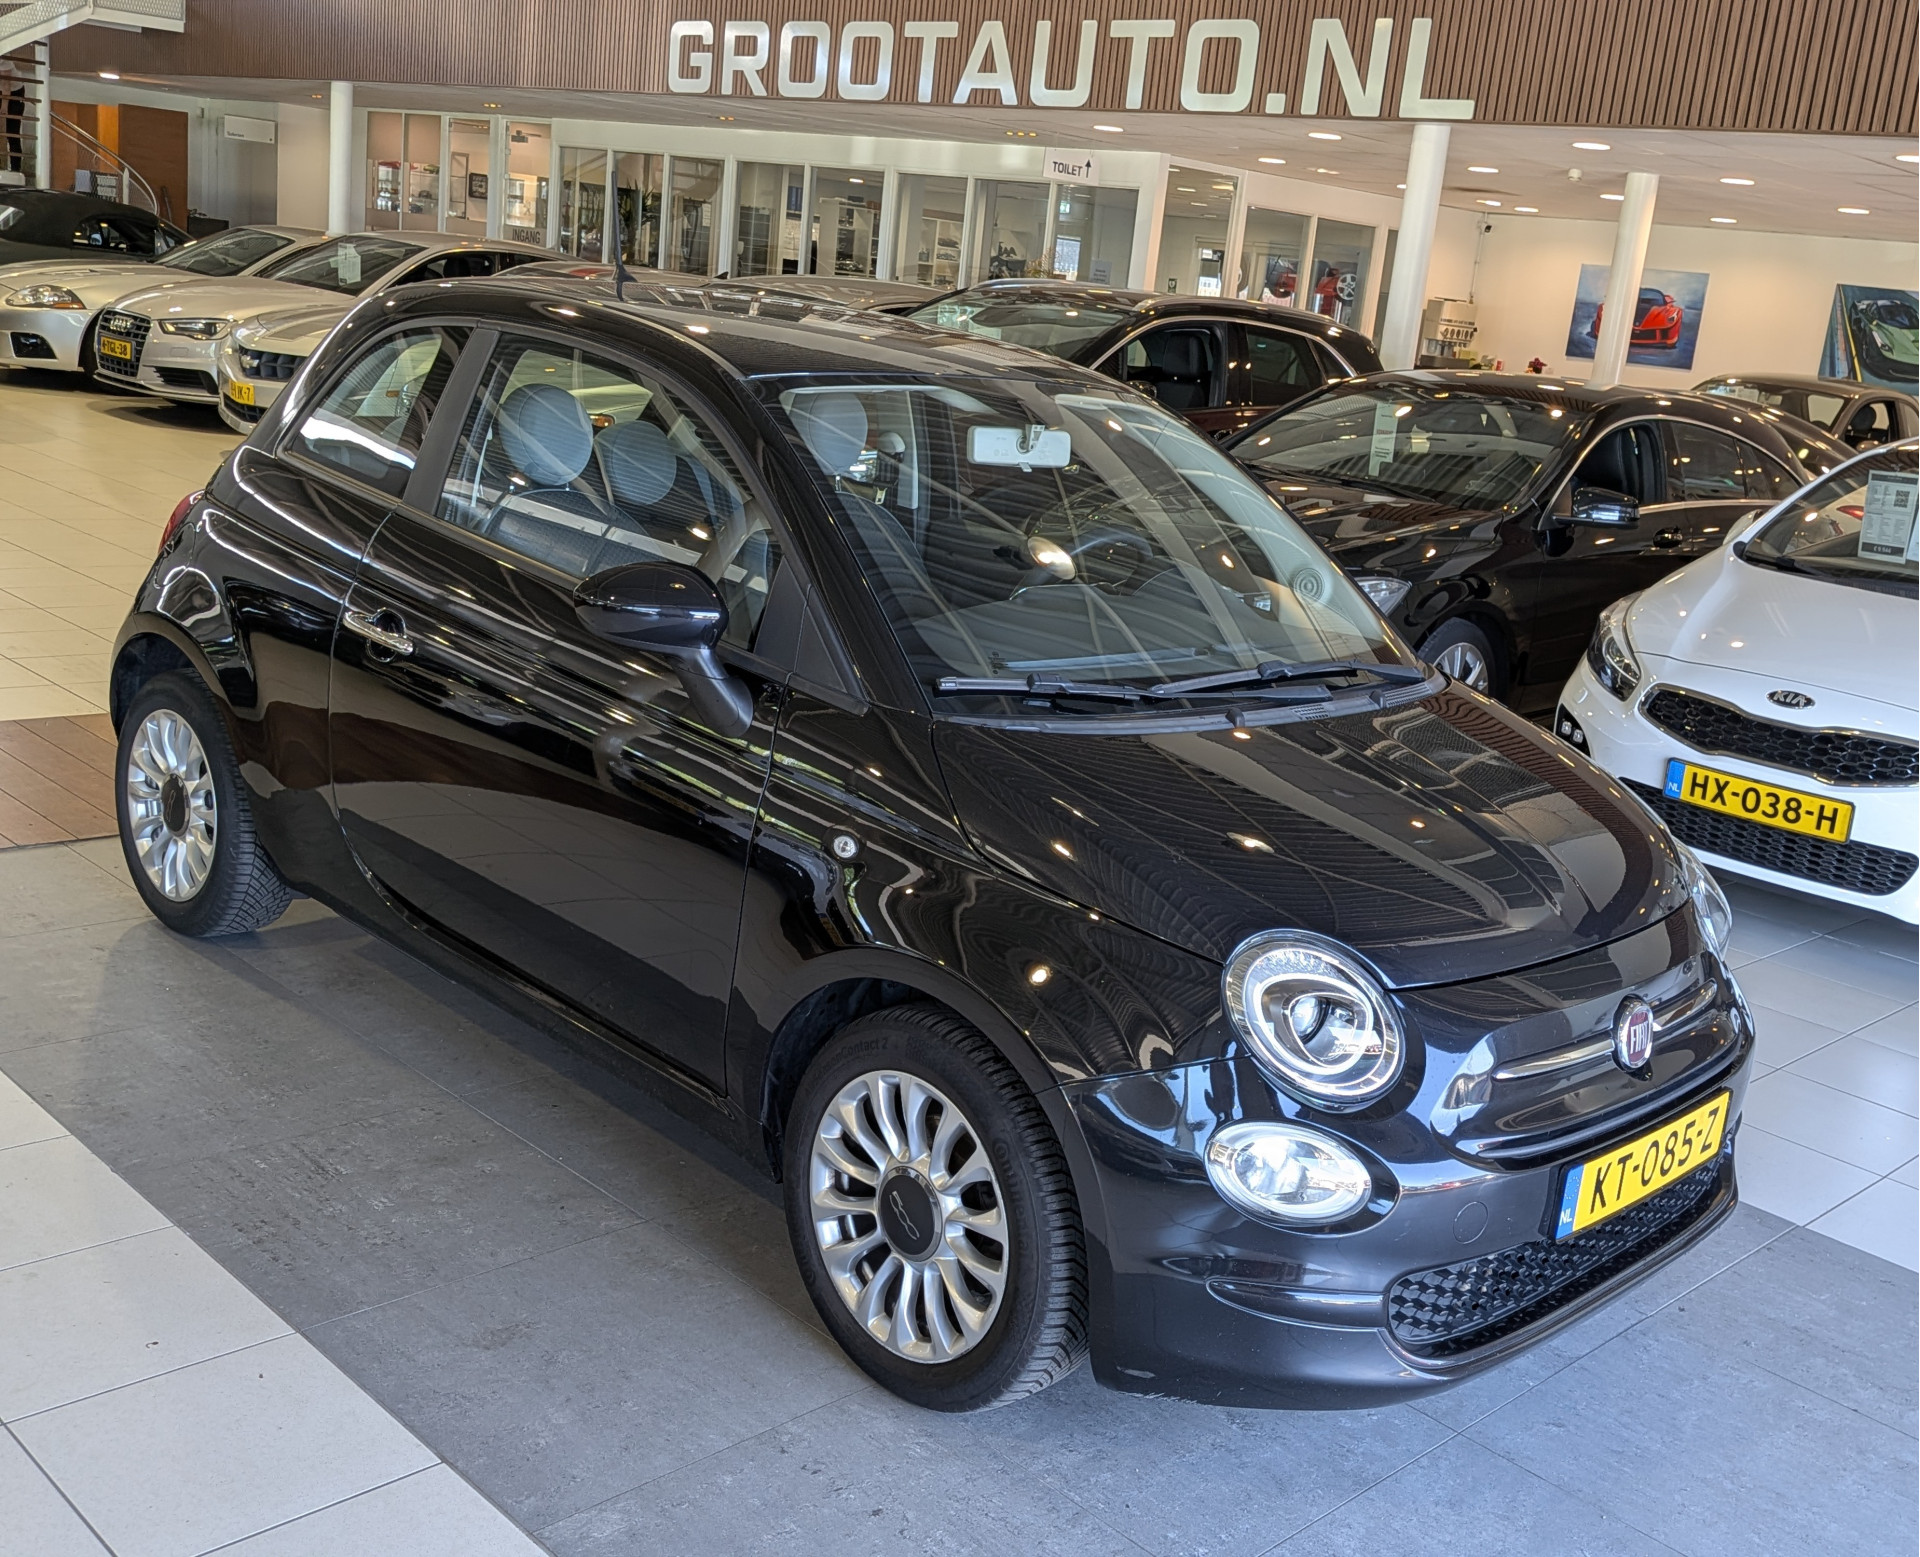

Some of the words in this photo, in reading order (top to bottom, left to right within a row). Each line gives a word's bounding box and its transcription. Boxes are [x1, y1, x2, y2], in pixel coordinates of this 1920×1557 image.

[667, 17, 1476, 121] GROOTAUTO.NL
[1052, 160, 1083, 177] TOILET
[512, 228, 541, 245] INGANG
[1773, 691, 1808, 708] KIA
[1667, 781, 1681, 793] NL
[1688, 771, 1839, 835] HX-038-H
[1629, 1020, 1649, 1055] FIAT
[1589, 1105, 1721, 1215] KT-085-Z
[1559, 1207, 1573, 1227] NL
